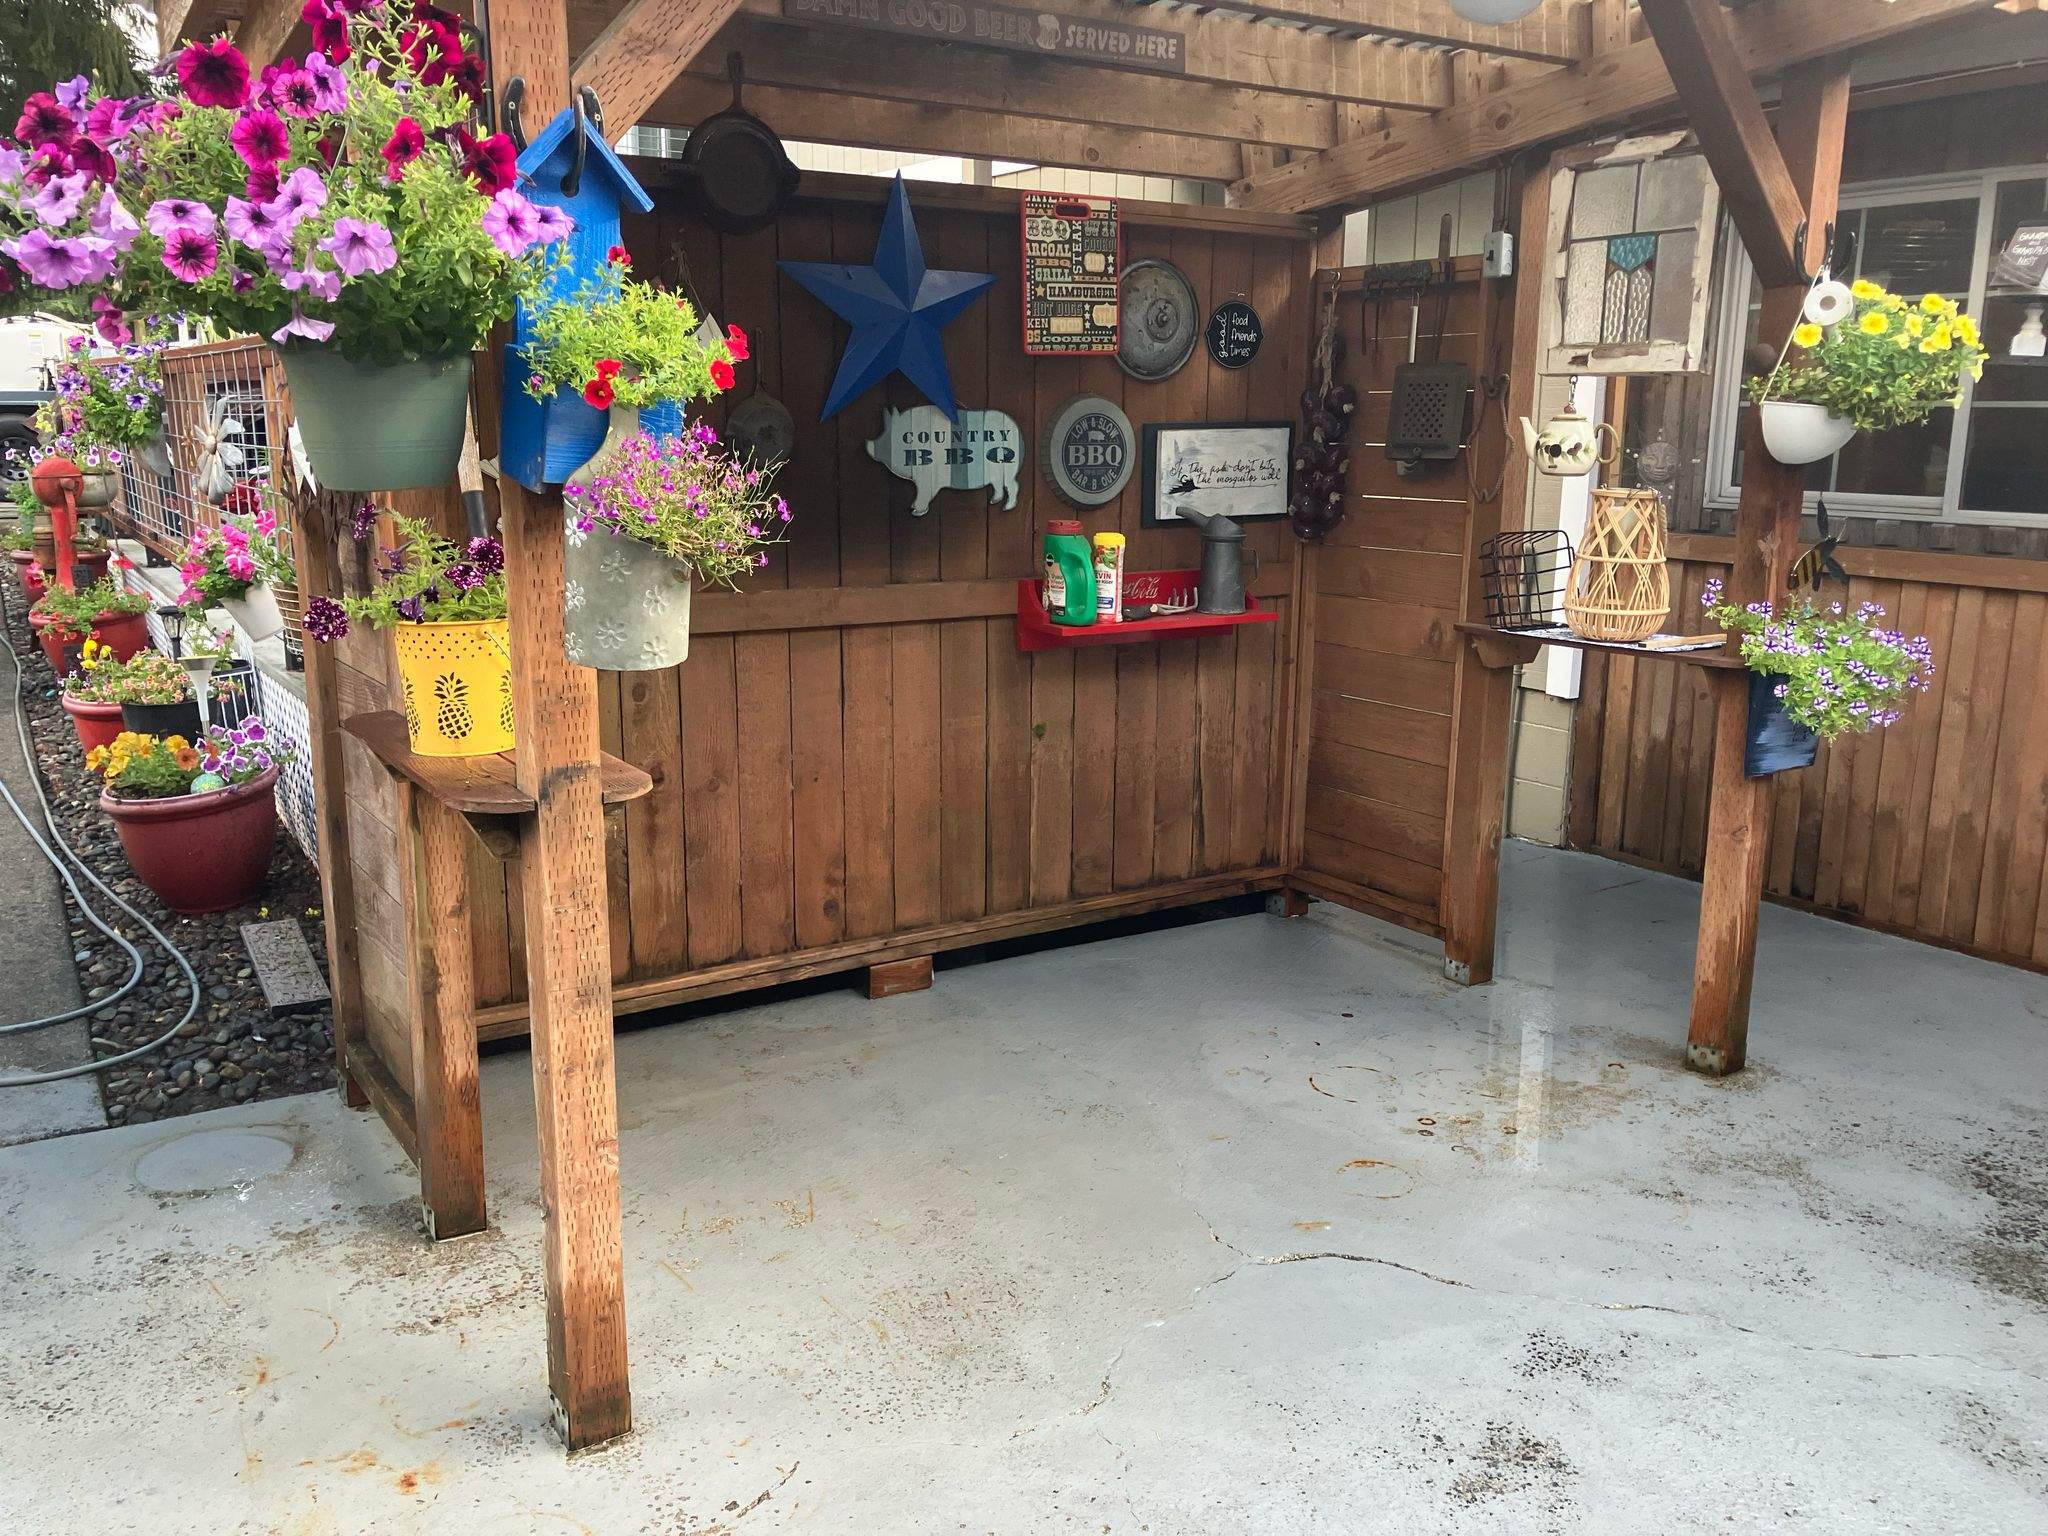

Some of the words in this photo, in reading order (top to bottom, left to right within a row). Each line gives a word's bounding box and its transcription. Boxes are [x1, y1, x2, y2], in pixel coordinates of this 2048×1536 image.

[888, 0, 966, 34] GOOD
[975, 8, 1034, 45] BEER
[1065, 24, 1130, 53] SERVED
[1134, 35, 1177, 60] HERE
[1027, 219, 1069, 239] BBQ
[1072, 220, 1082, 274] STEAK
[1035, 267, 1072, 282] GRILL
[1027, 318, 1048, 329] KEN
[1232, 312, 1249, 326] food
[1216, 312, 1228, 357] good
[1231, 328, 1257, 342] friends
[1230, 343, 1250, 356] times
[902, 430, 1011, 444] COUNTRY
[1071, 418, 1089, 440] LOW
[1098, 418, 1120, 440] SLOW
[904, 446, 1016, 466] BBQ
[1068, 444, 1123, 467] BBQ
[1071, 468, 1088, 488] BAR
[1101, 469, 1118, 487] QUE
